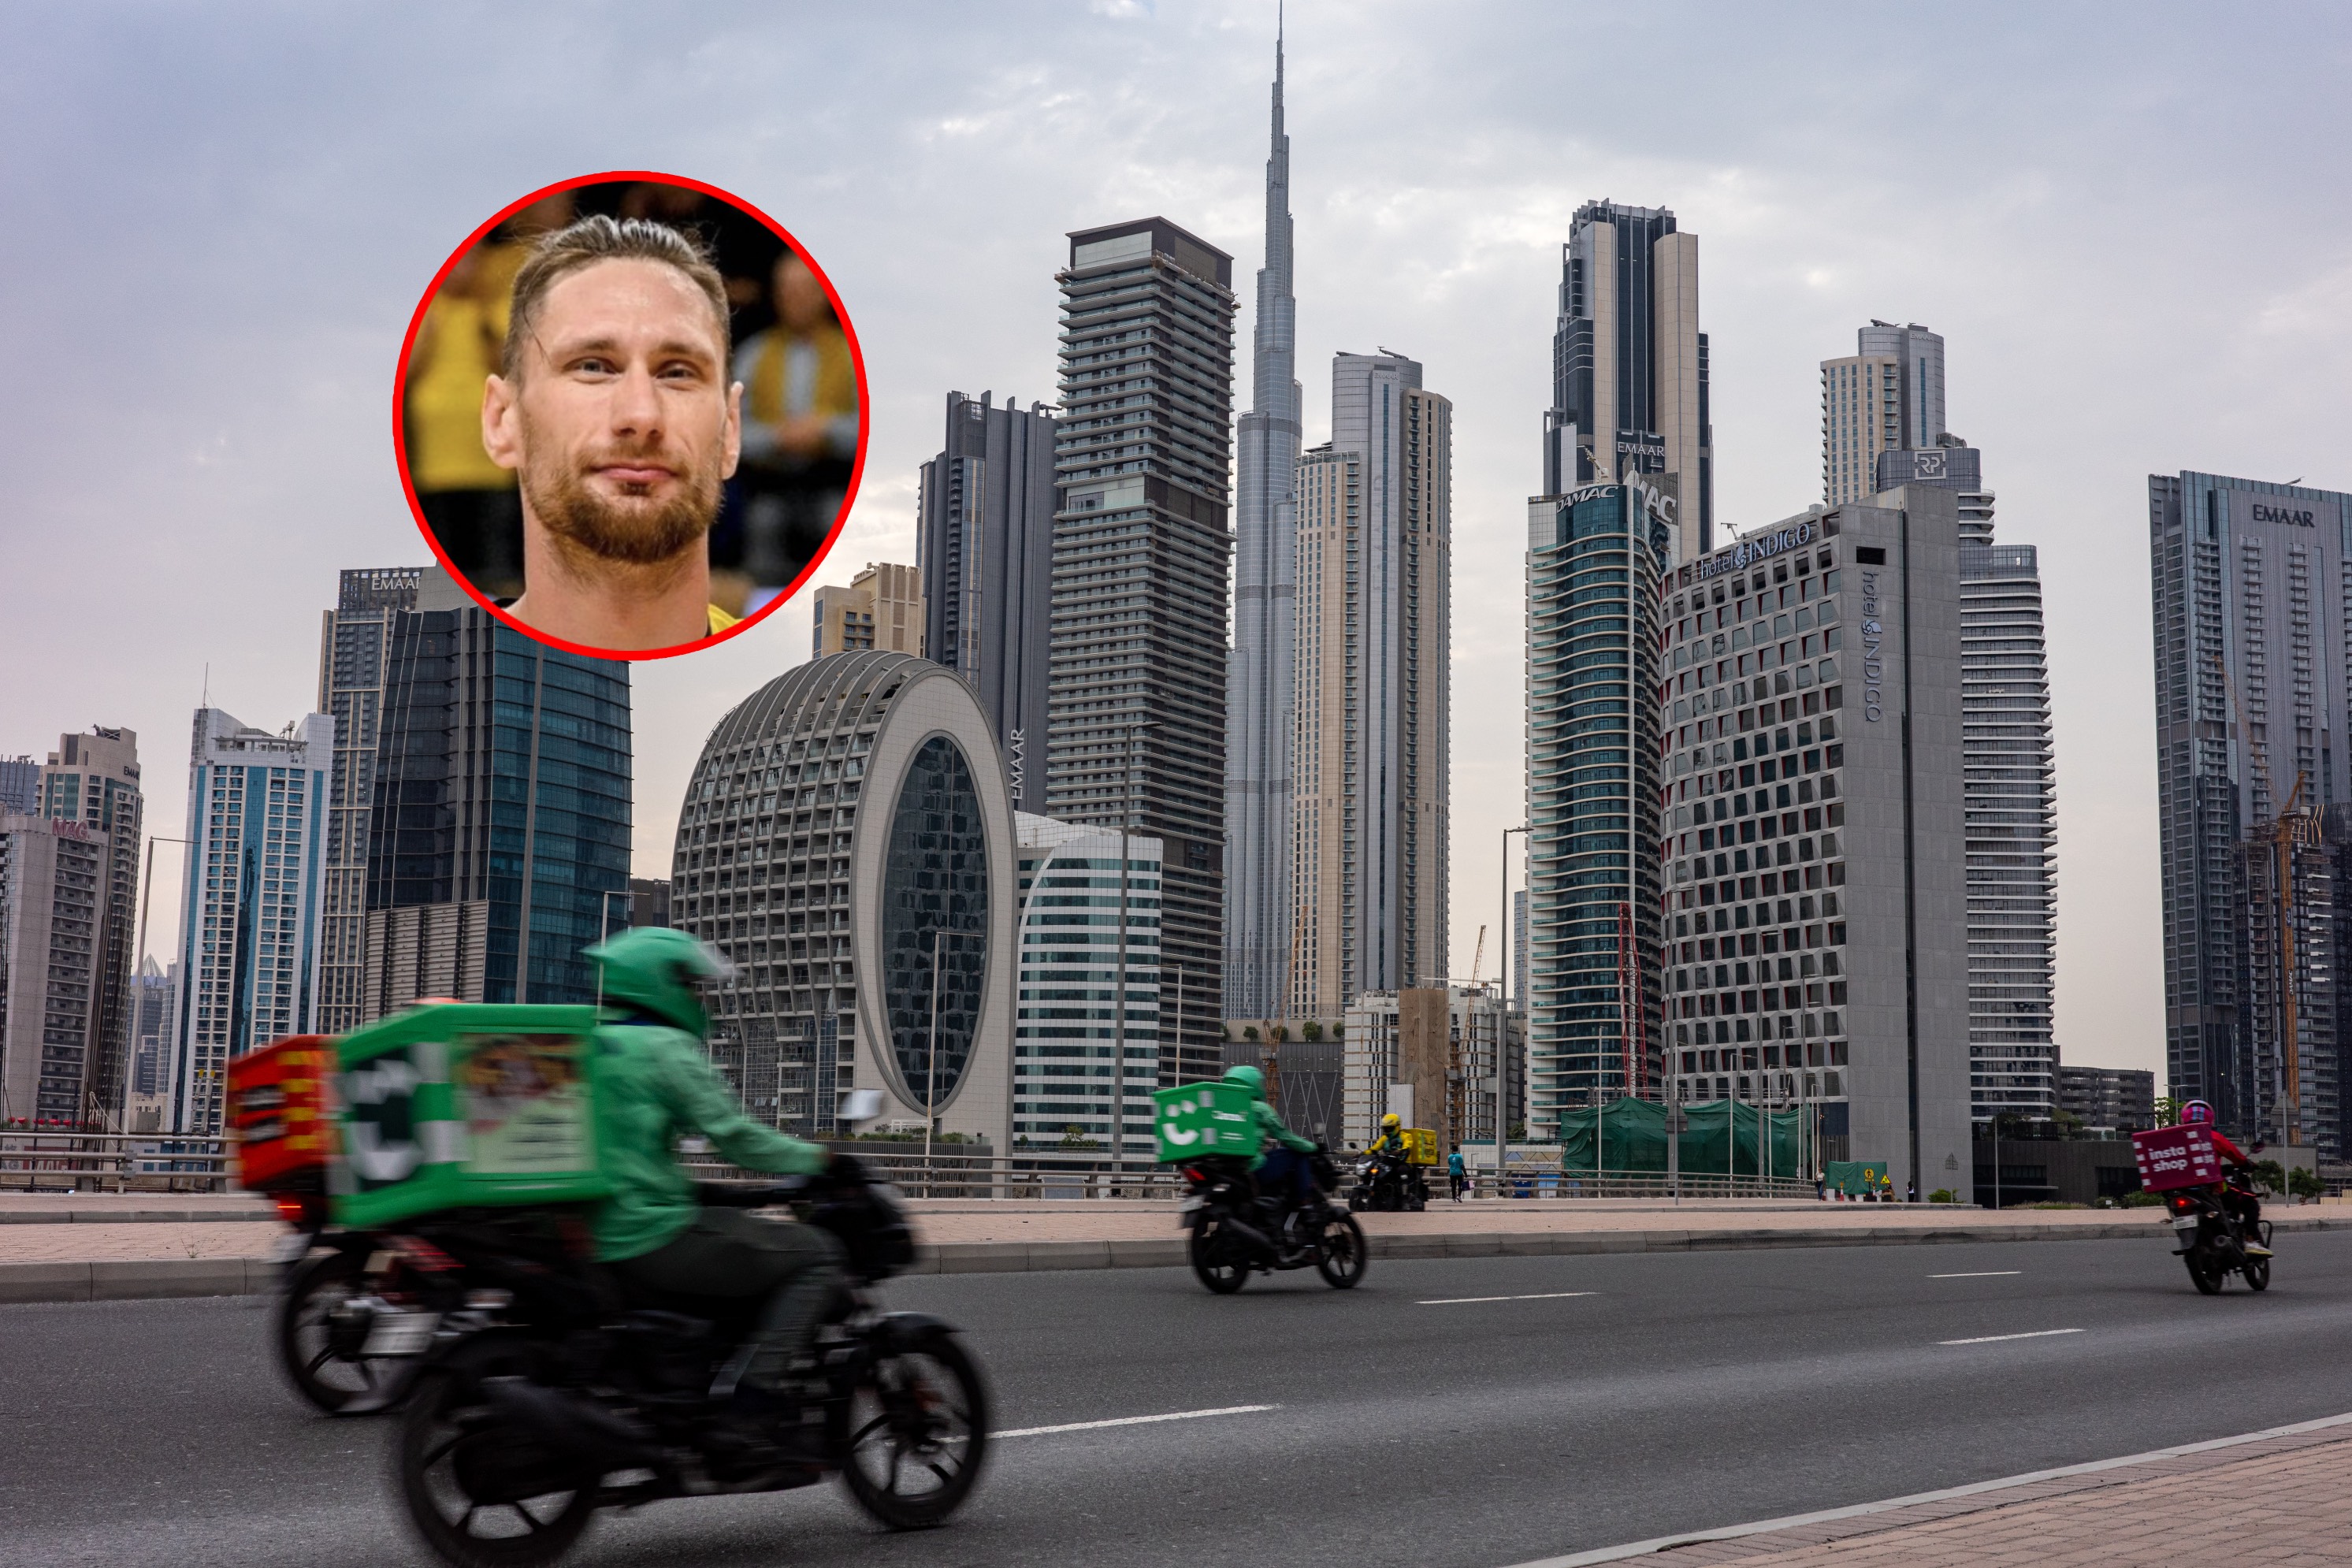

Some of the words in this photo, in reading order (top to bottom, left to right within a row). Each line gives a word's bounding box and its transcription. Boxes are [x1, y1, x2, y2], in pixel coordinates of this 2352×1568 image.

[1618, 442, 1665, 457] EMAAR
[2254, 504, 2316, 528] EMAAR
[1700, 549, 1734, 580] hotel
[1749, 523, 1811, 563] INDIGO
[1863, 571, 1880, 617] hotel
[1864, 637, 1882, 723] INDIGO
[1009, 728, 1024, 800] EMAAR
[2148, 1146, 2187, 1161] insta
[2153, 1159, 2188, 1172] shop
